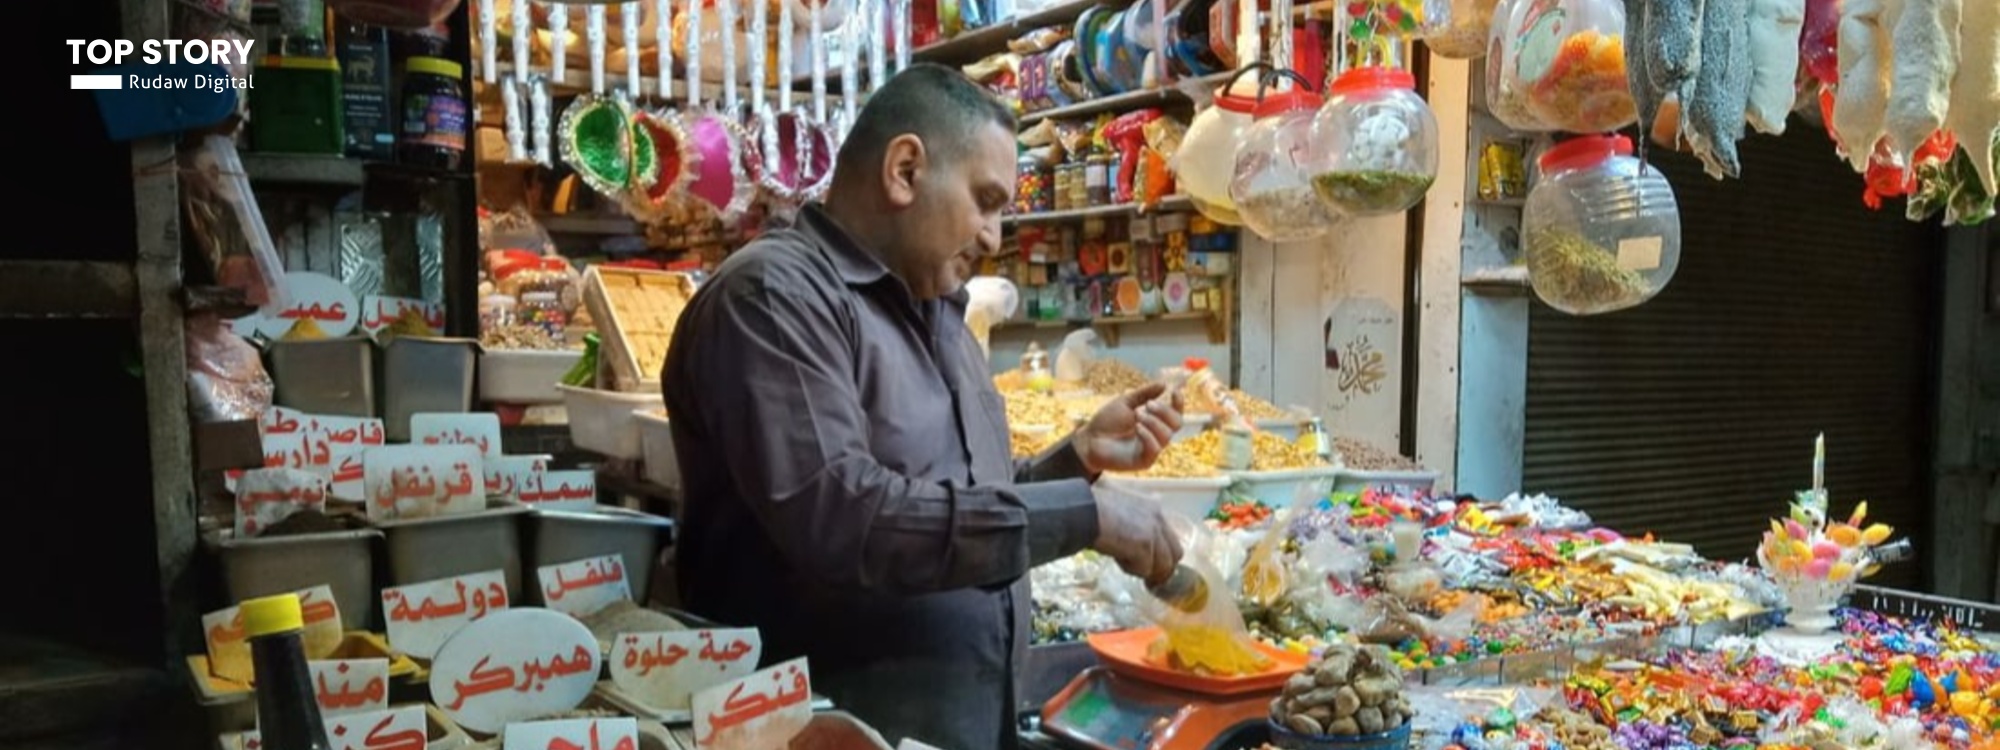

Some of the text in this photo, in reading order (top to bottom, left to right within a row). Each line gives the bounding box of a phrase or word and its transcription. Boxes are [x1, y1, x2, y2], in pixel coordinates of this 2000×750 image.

[375, 462, 472, 508] قرنفل
[382, 579, 506, 621] دولمة
[546, 557, 622, 600] فلفل
[624, 629, 752, 676] حبة حلوة
[444, 645, 593, 711] همبركر
